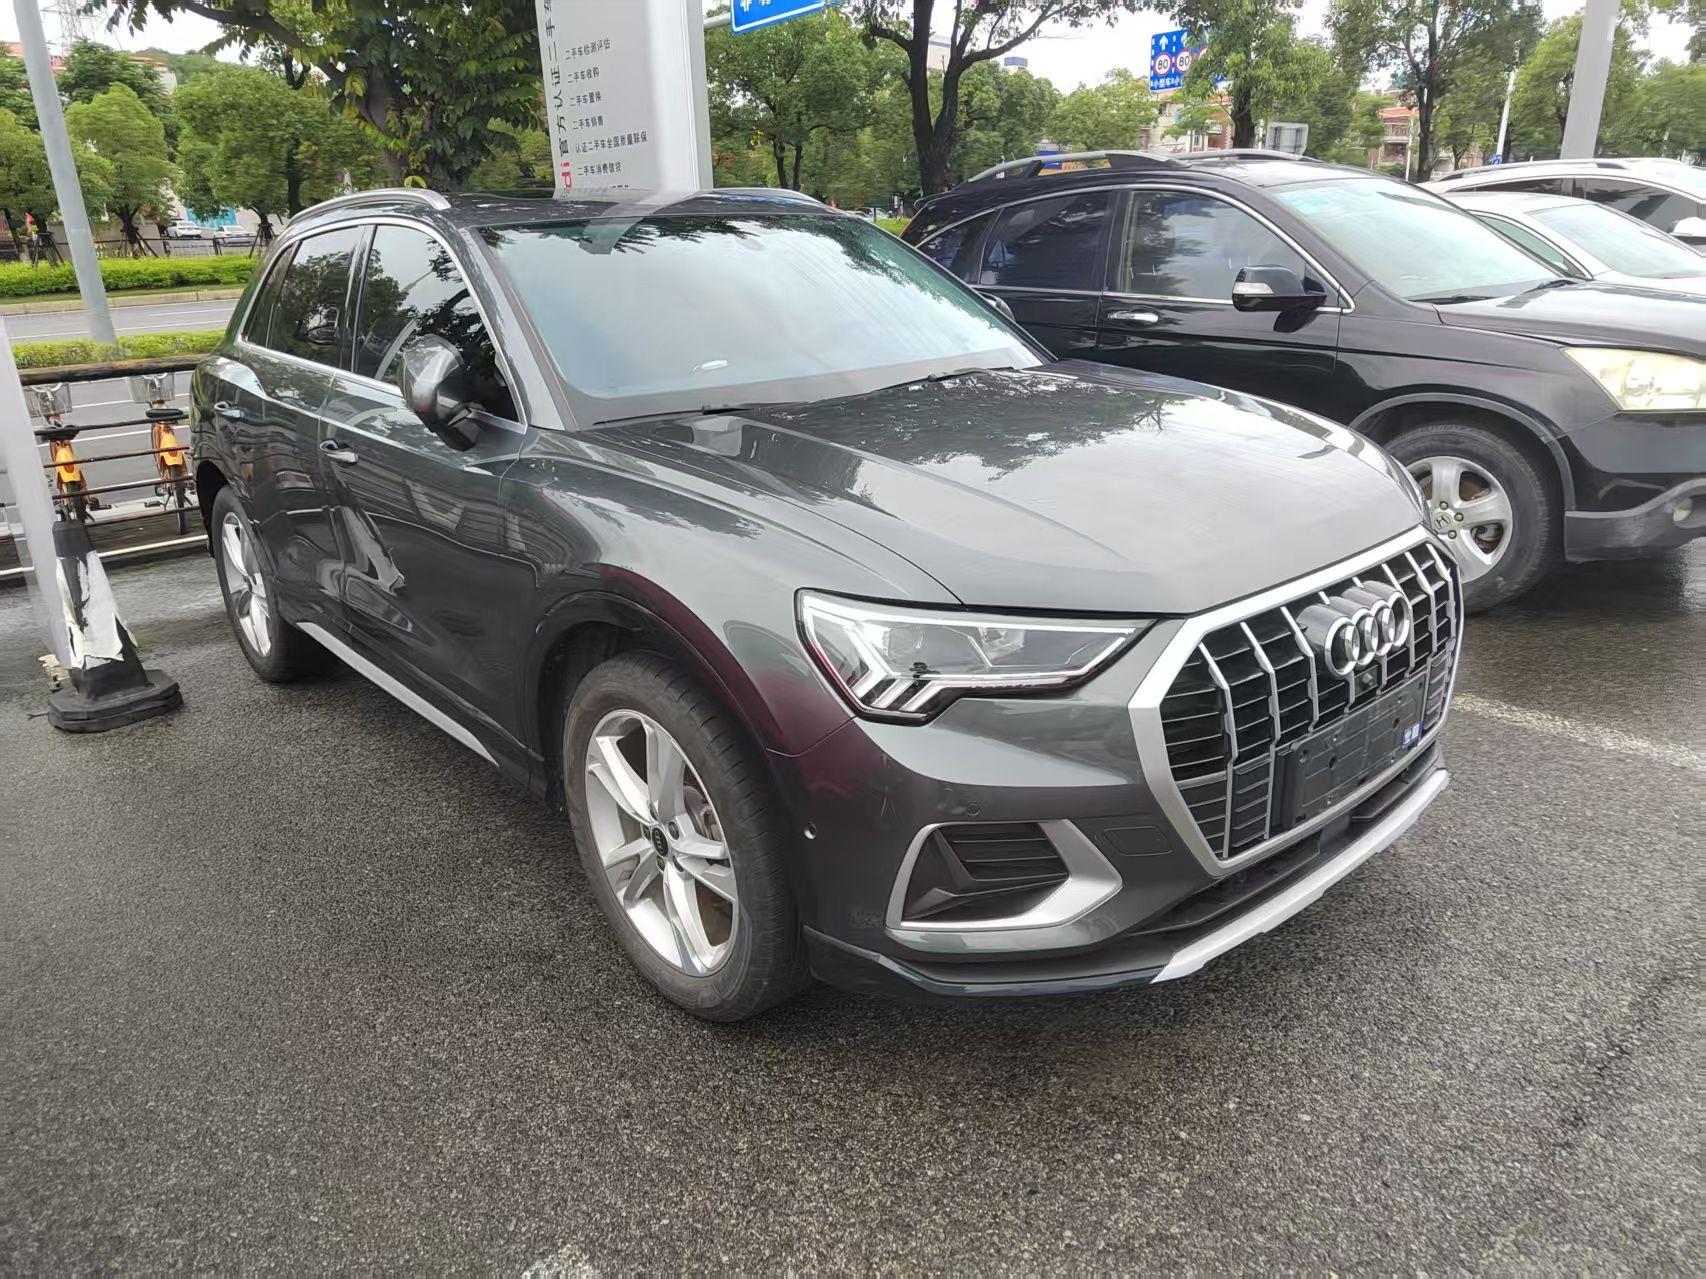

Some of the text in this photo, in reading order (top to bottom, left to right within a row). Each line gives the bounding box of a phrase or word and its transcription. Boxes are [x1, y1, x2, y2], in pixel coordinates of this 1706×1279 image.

[565, 38, 611, 60] 二手车检测评估
[1158, 59, 1168, 70] 80
[1179, 56, 1189, 67] 80
[567, 66, 600, 84] 二手车收购
[569, 91, 602, 107] 二手车置换
[572, 115, 604, 131] 二手车销售
[575, 130, 648, 154] 认证二手车全国质量联保
[577, 161, 622, 177] 二手车消费信贷
